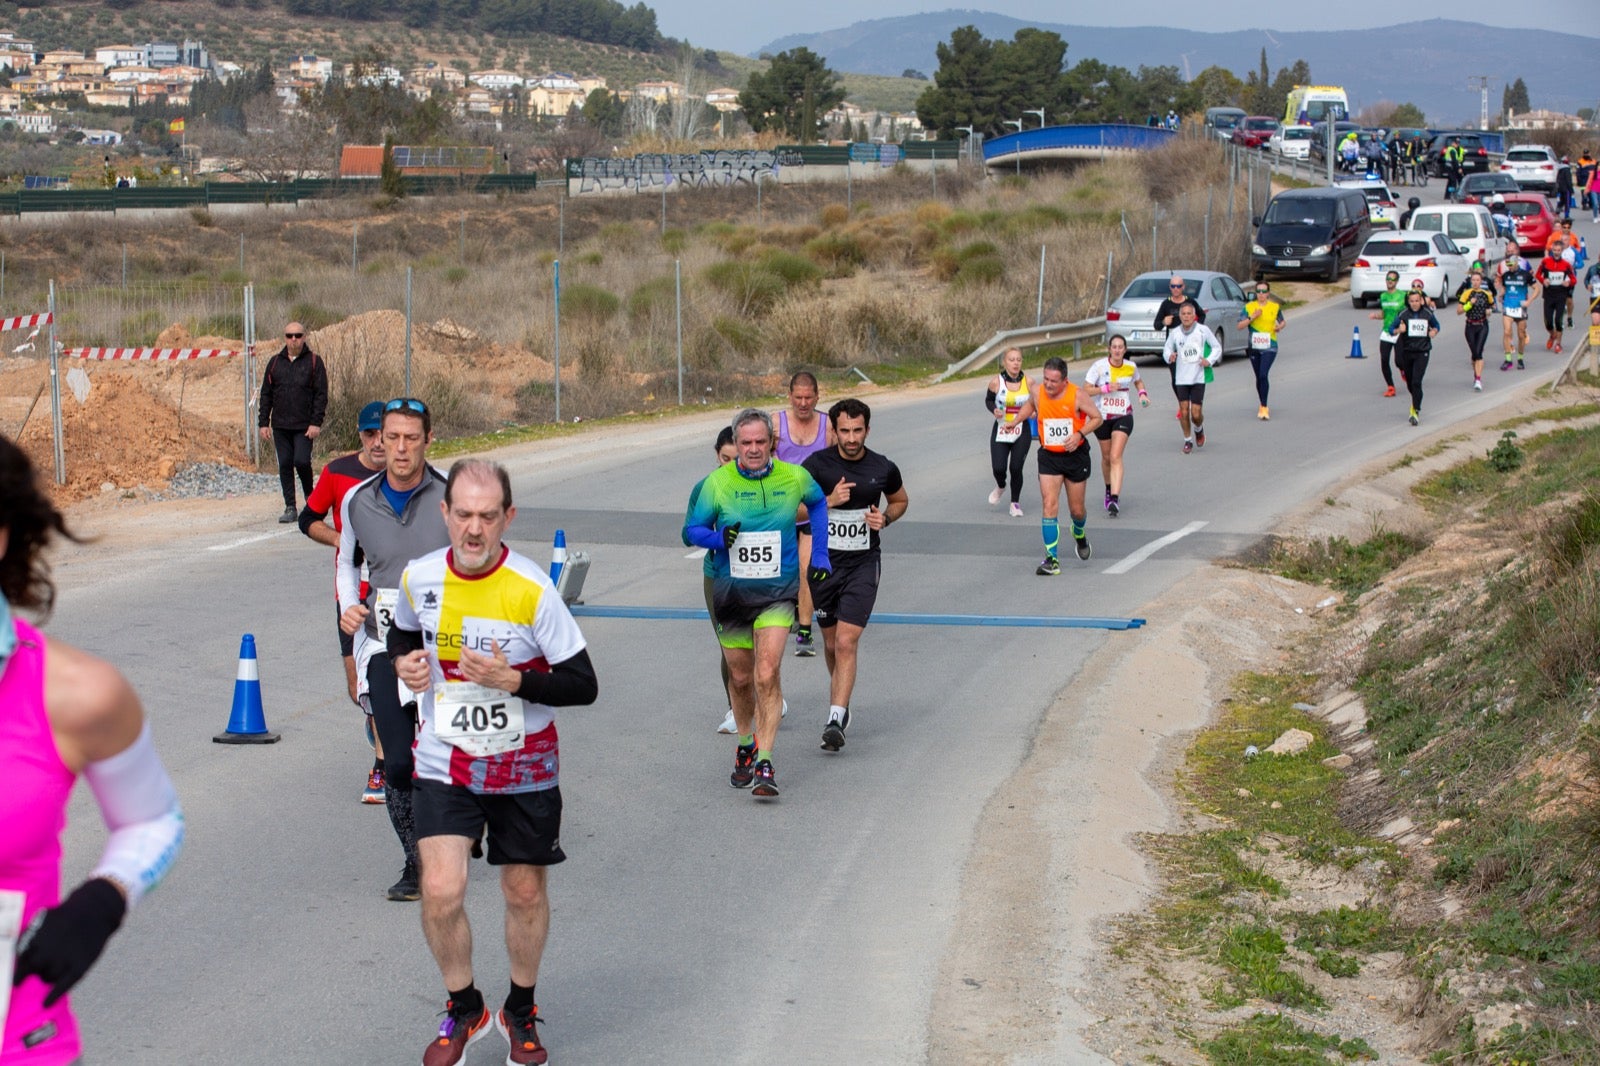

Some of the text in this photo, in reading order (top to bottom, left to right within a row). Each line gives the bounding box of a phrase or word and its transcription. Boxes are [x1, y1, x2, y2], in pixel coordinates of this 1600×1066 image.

[1184, 350, 1198, 358] 688
[1103, 397, 1126, 407] 2088
[1049, 427, 1069, 437] 303
[828, 523, 868, 538] 3004
[738, 546, 772, 563] 855
[380, 609, 391, 627] 3
[451, 703, 508, 732] 405
